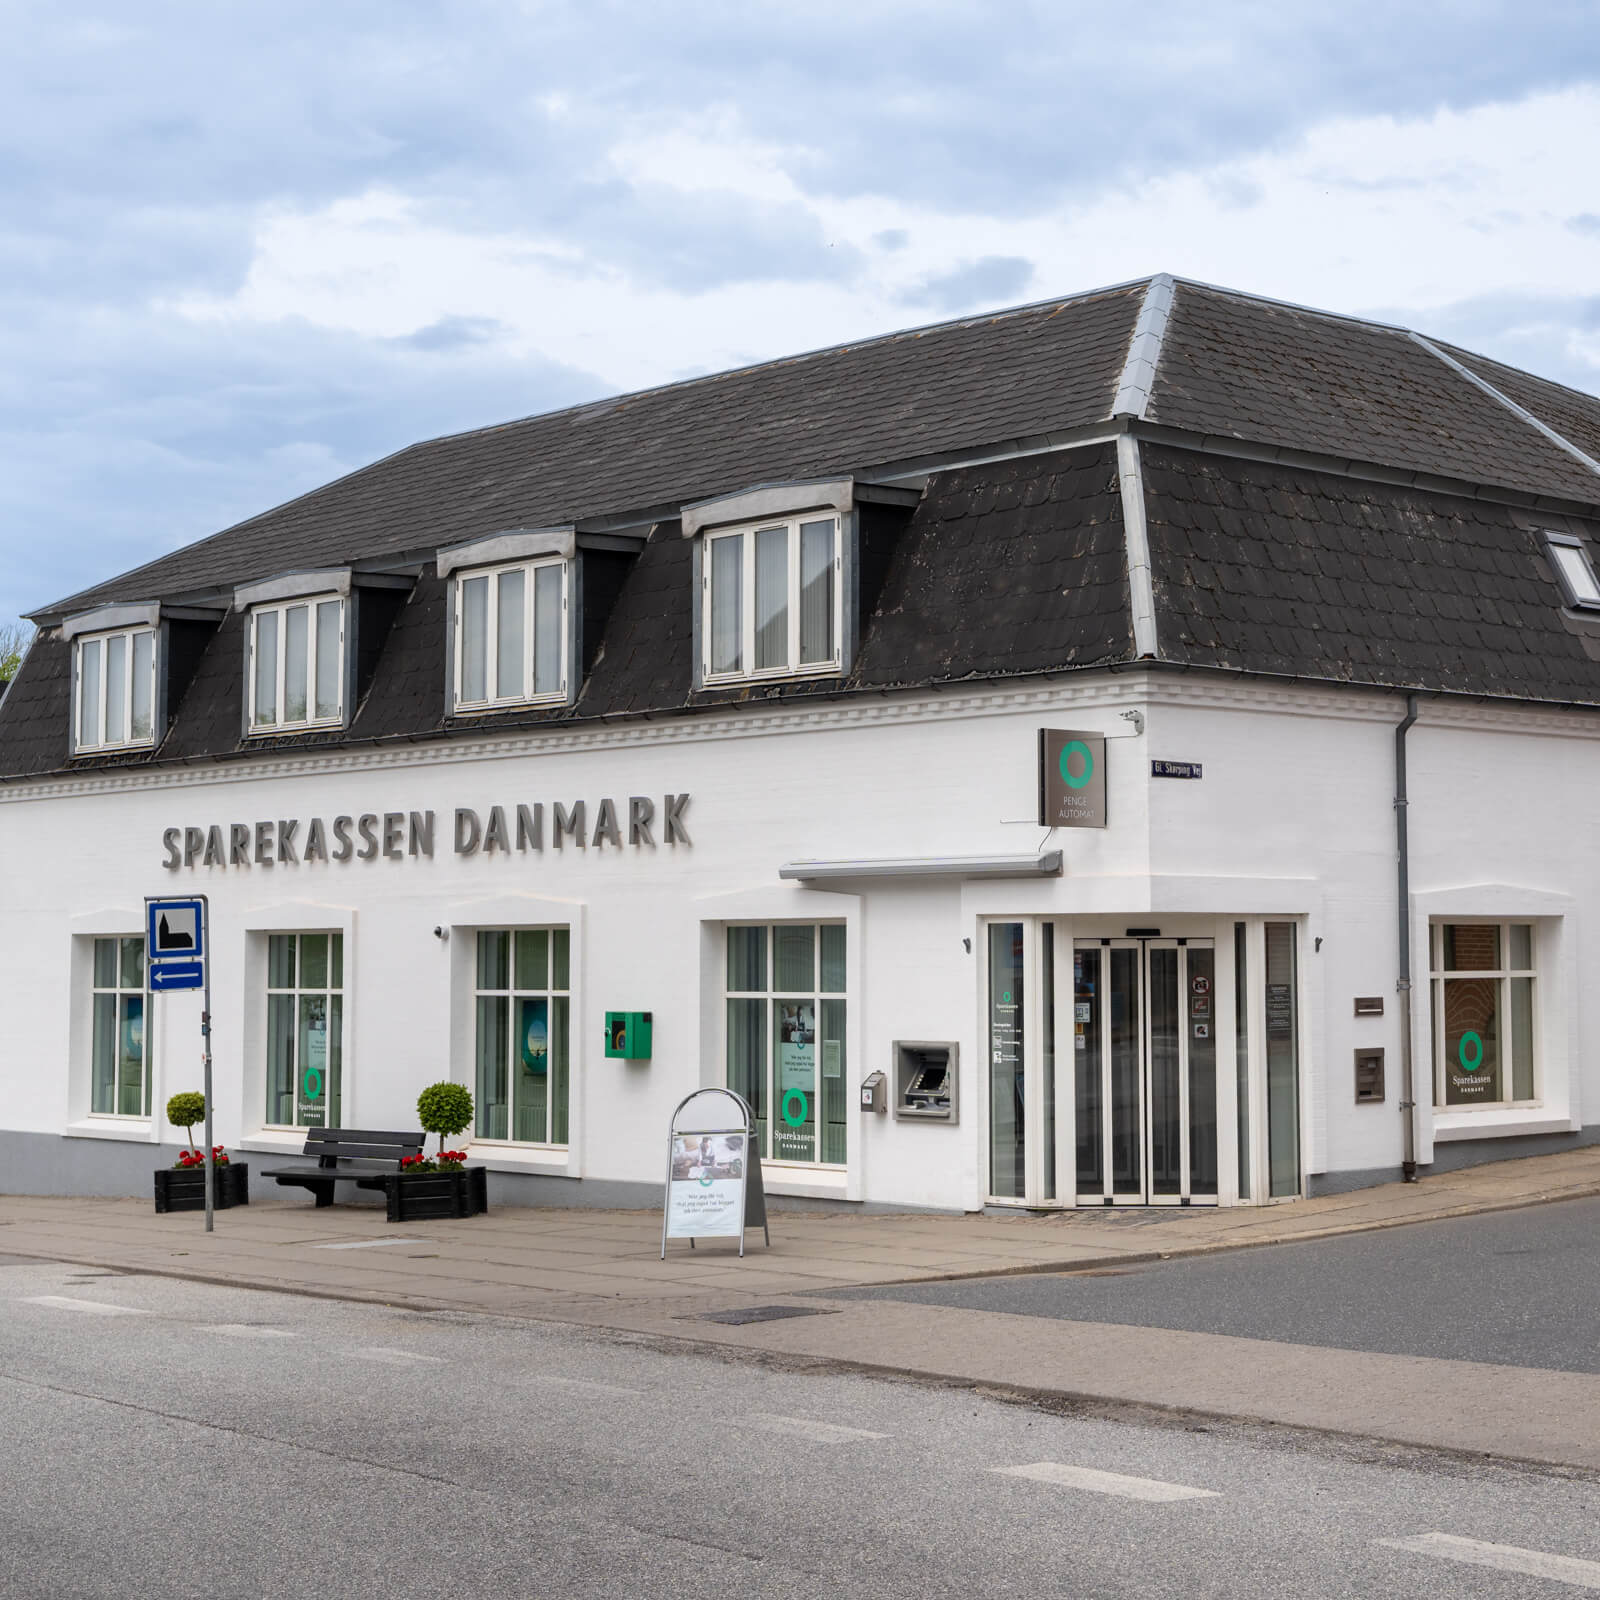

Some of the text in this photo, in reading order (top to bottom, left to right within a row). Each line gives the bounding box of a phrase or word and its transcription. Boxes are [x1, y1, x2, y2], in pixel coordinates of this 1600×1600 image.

[1063, 796, 1088, 806] PENGE
[1058, 808, 1096, 818] AUTOMAT
[162, 793, 692, 870] SPAREKASSEN DANMARK
[1452, 1074, 1491, 1087] Sparekassen
